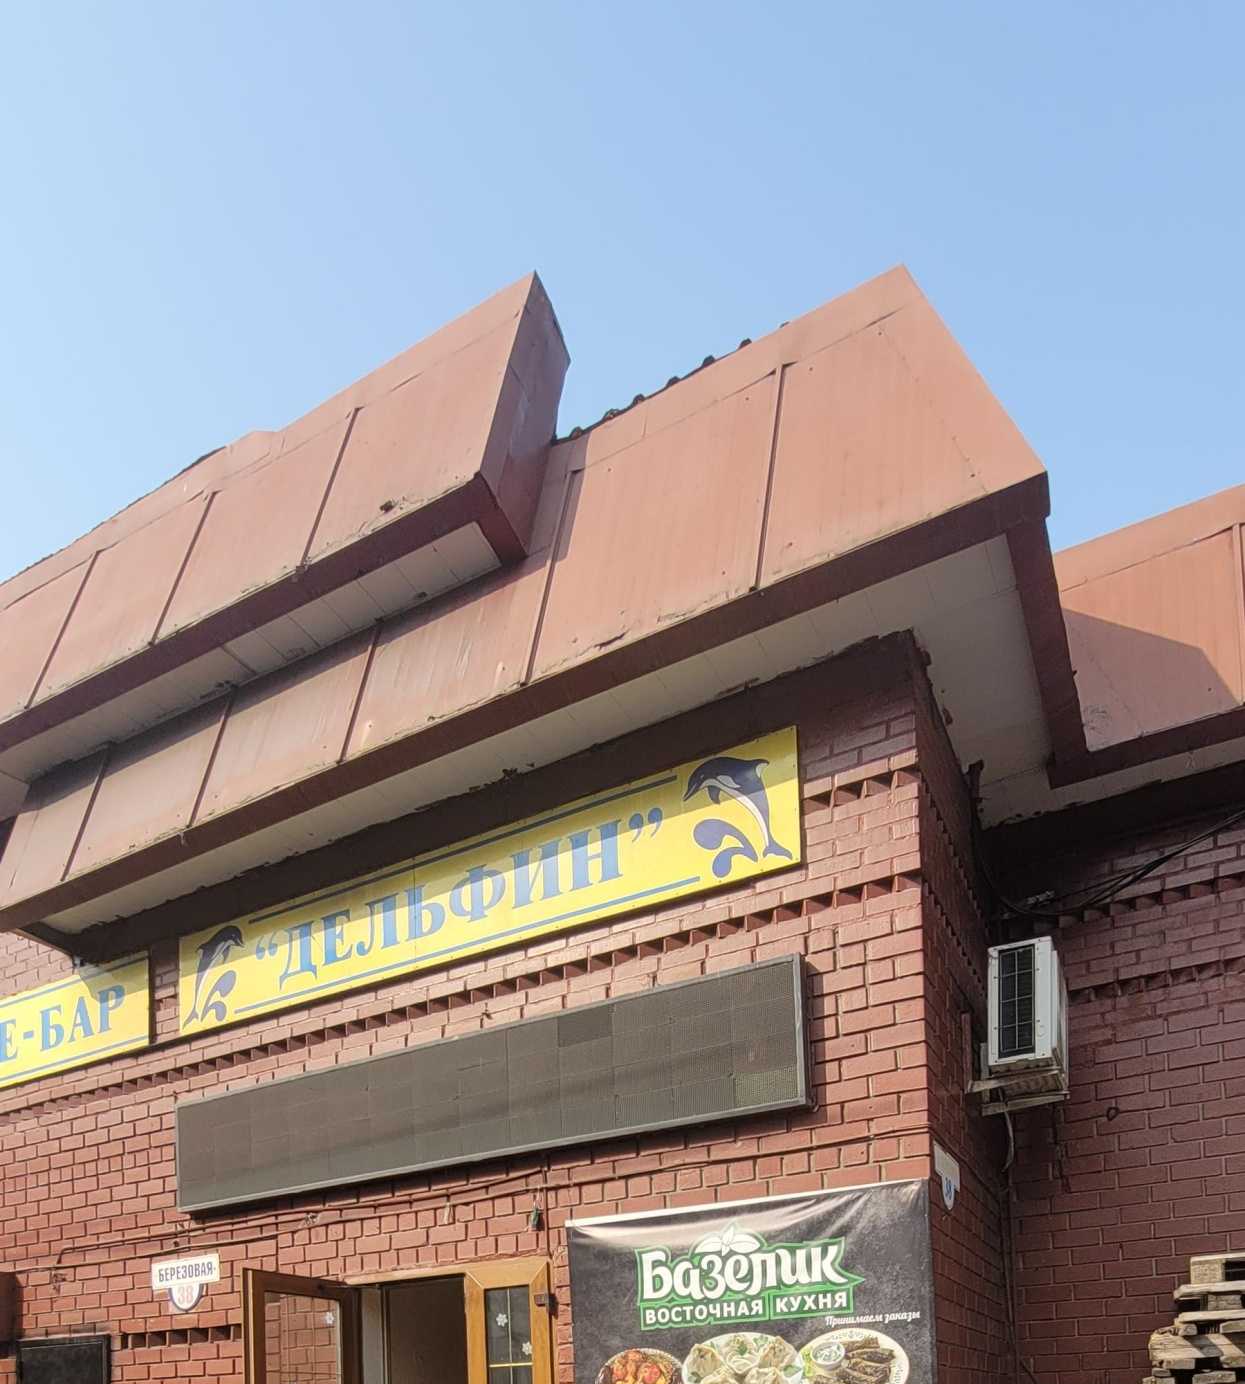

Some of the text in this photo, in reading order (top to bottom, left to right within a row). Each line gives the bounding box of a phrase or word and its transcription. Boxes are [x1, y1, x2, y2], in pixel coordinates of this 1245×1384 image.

[158, 1261, 213, 1282] БЕРЕЗОВАЯ
[641, 1247, 848, 1300] Базелик
[177, 1285, 194, 1305] 38
[645, 1290, 848, 1325] ВОСТОЧНАЯ КУХНЯ
[824, 1309, 921, 1328] Принимаем заказы
